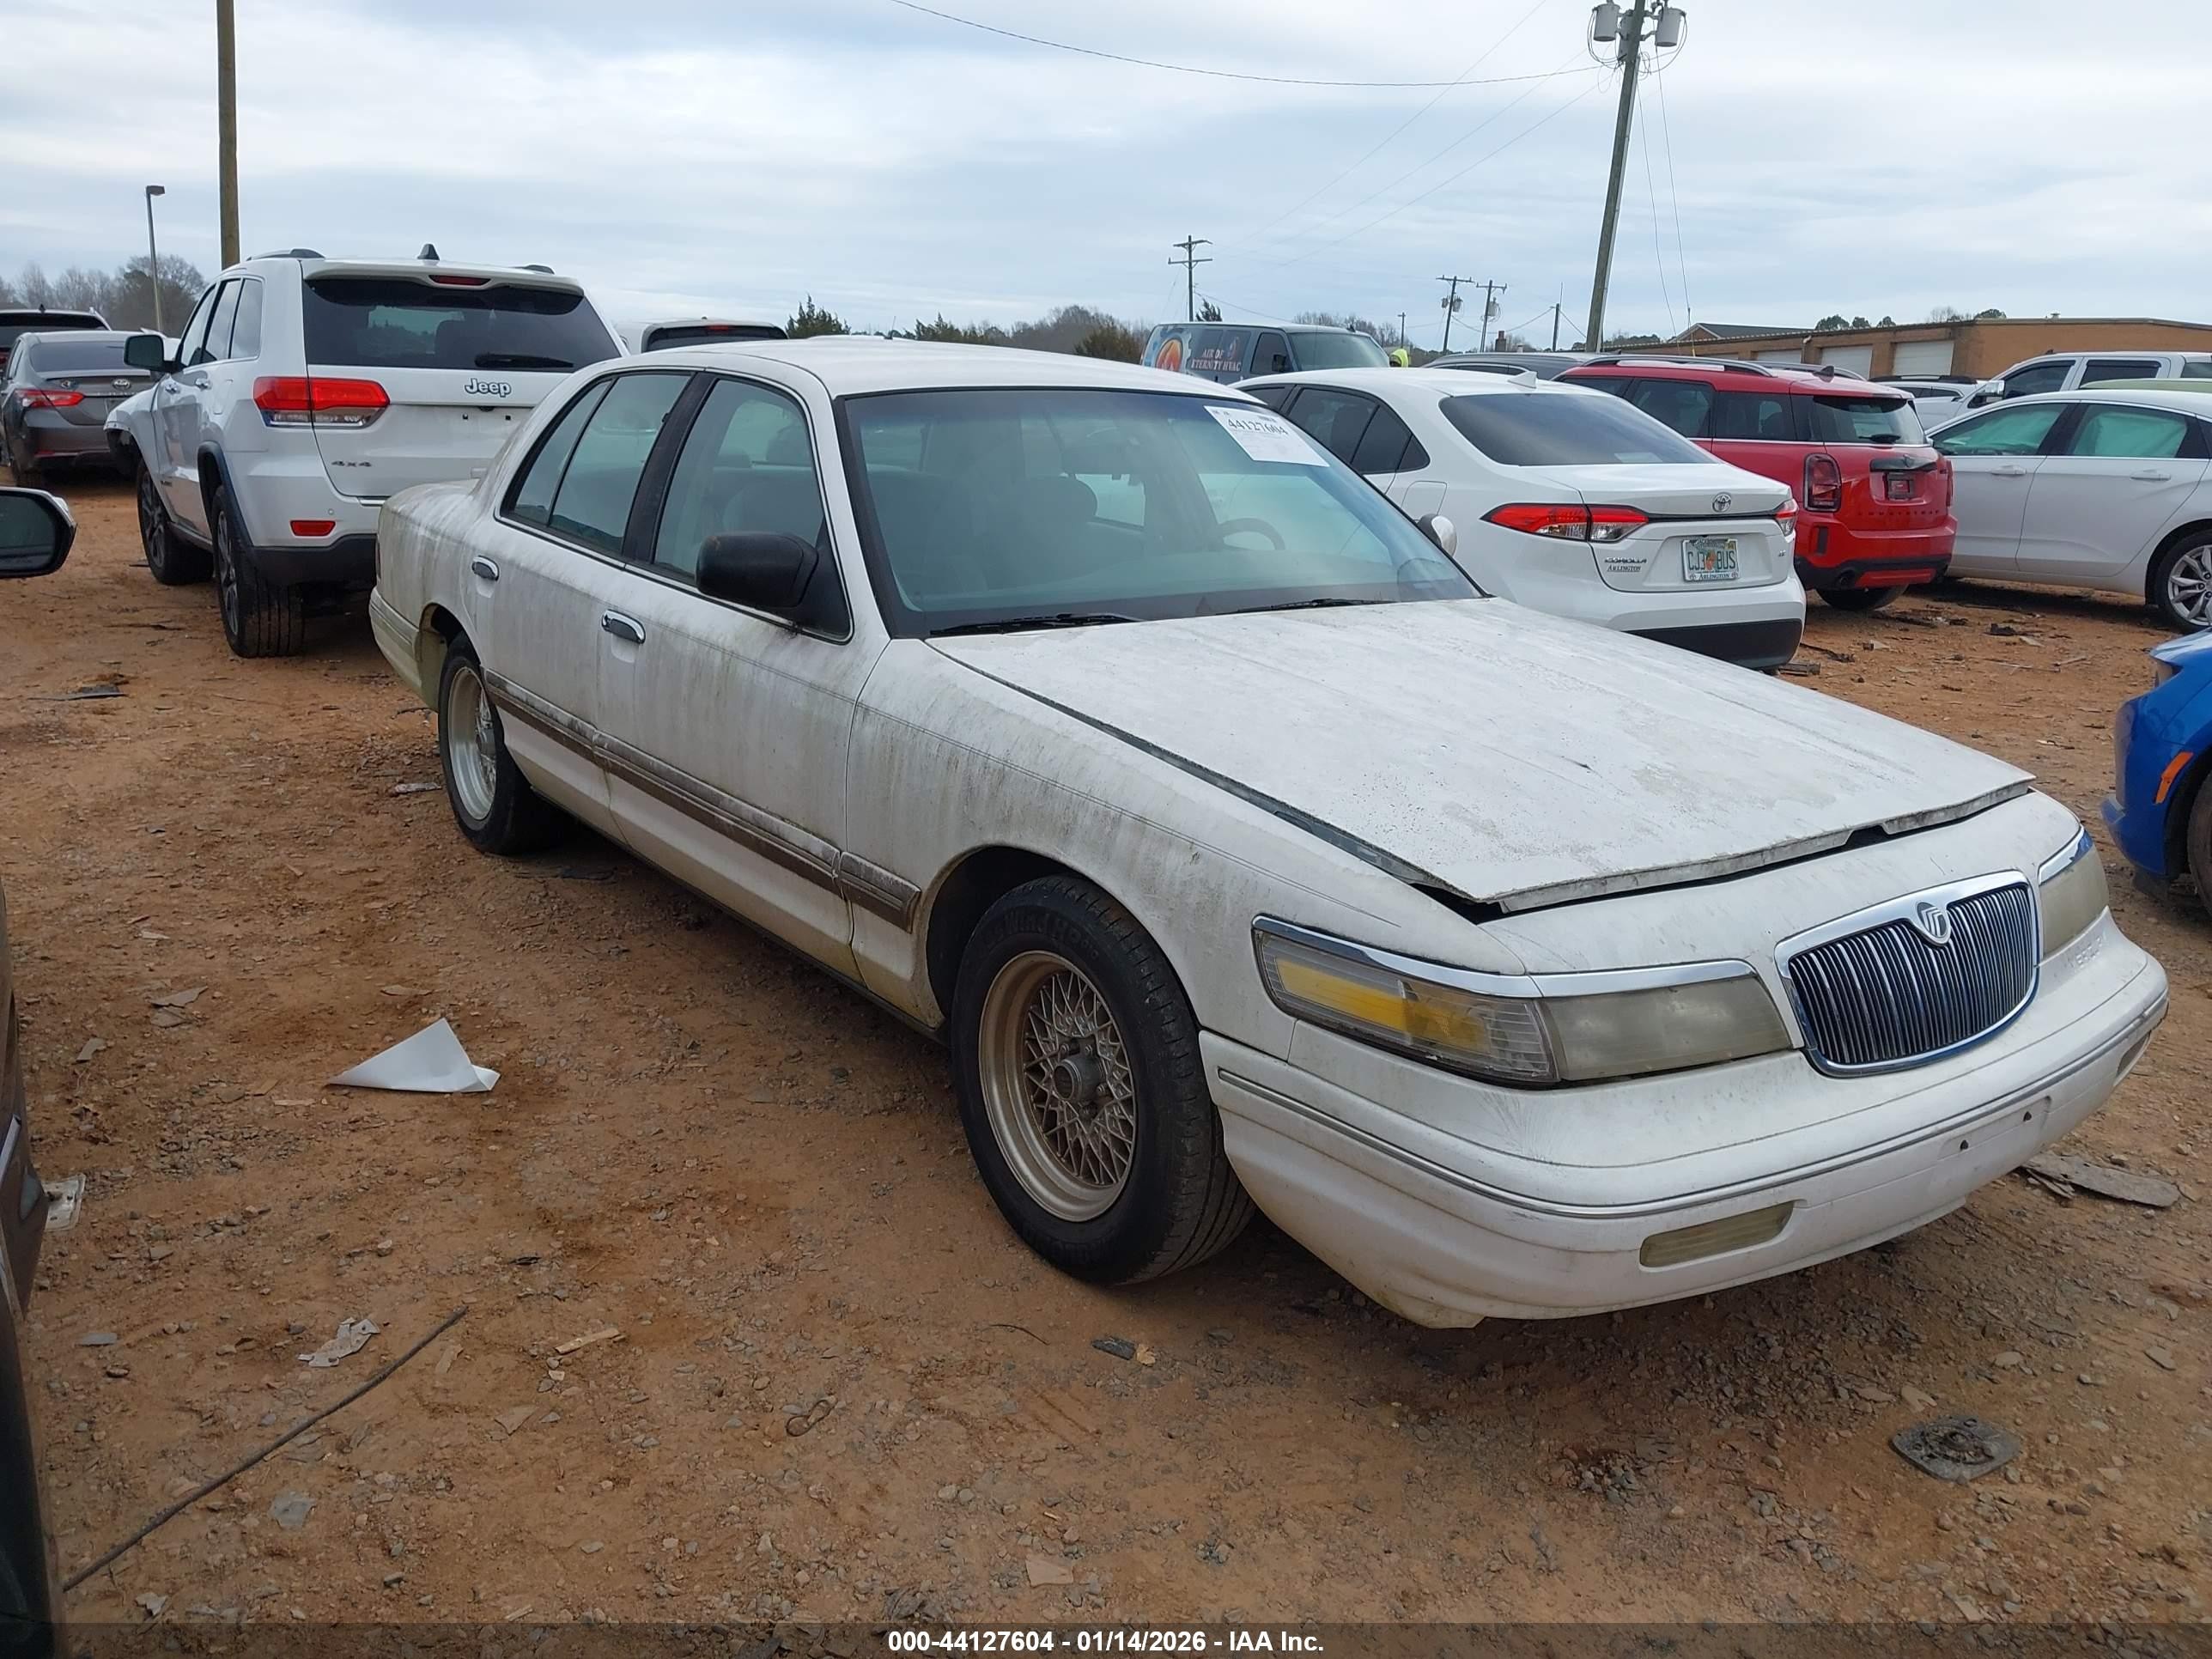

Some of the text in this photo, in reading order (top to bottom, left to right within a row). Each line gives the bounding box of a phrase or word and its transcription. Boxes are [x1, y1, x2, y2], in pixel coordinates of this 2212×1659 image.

[1202, 349, 1224, 359] AIR OF
[1223, 361, 1242, 372] HVAC
[464, 377, 512, 398] Jeep
